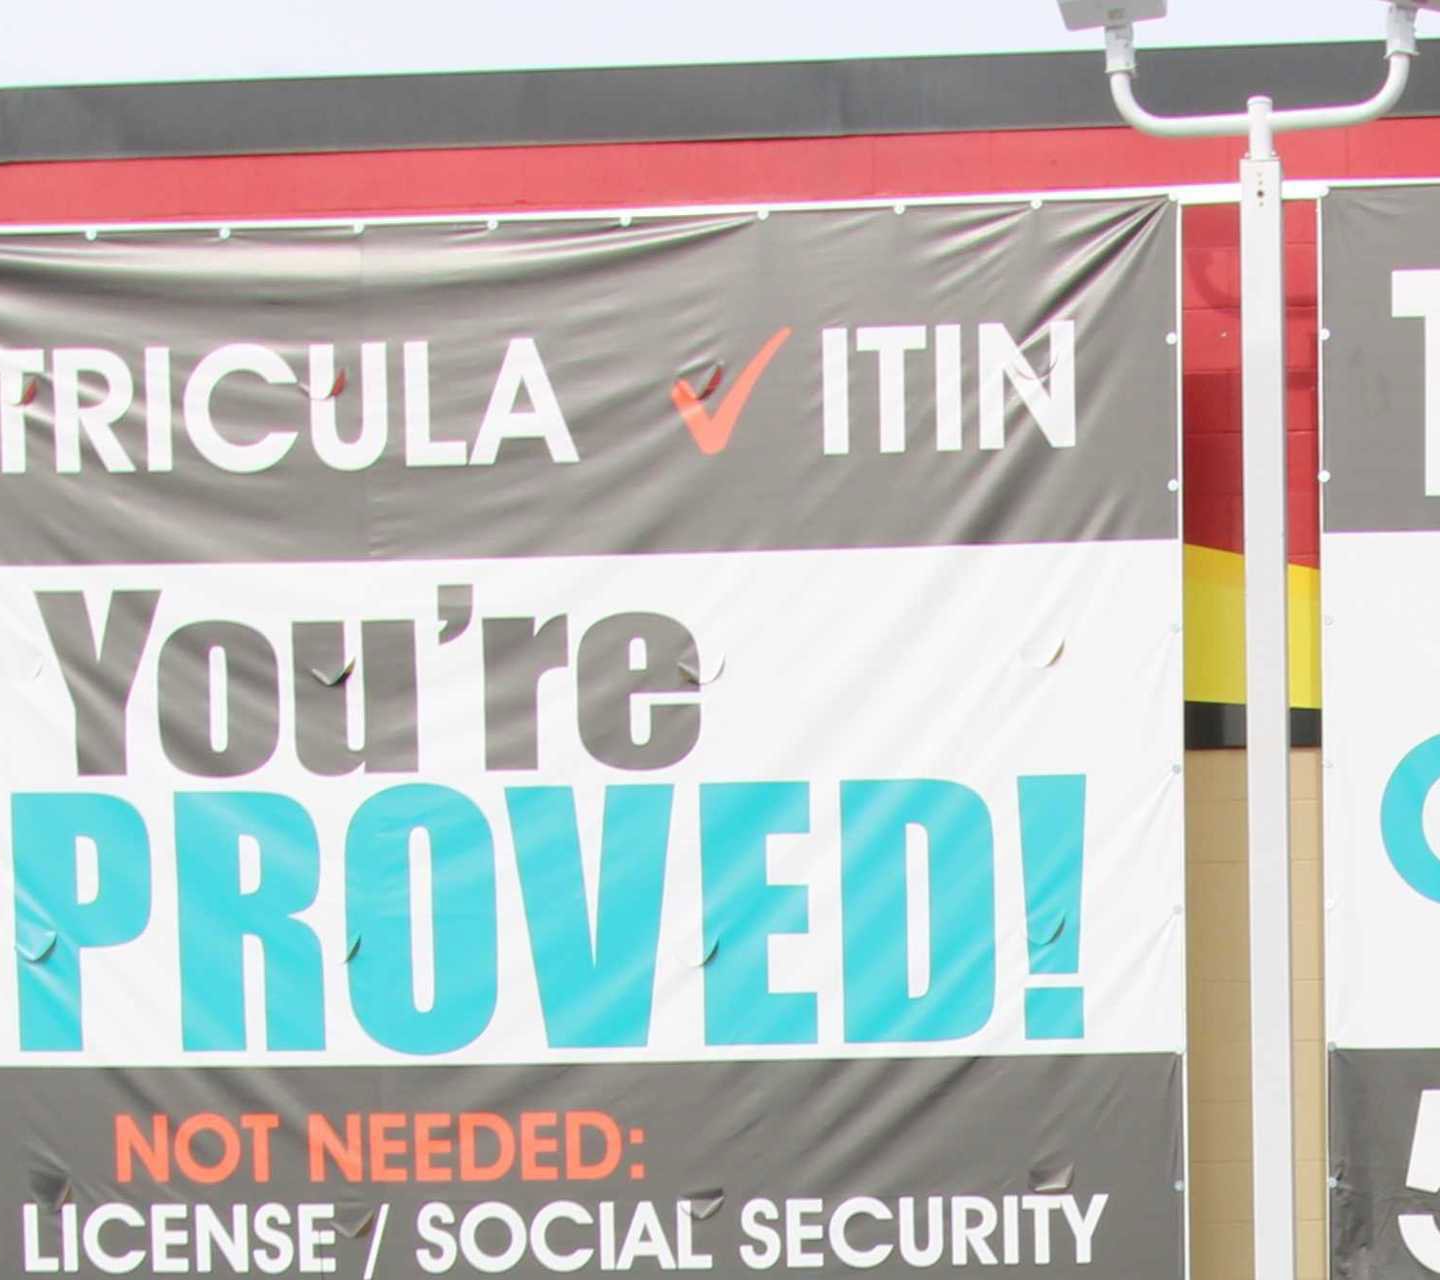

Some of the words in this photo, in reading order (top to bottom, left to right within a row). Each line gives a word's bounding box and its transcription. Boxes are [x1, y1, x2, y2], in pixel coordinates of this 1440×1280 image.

[820, 321, 1077, 455] ITIN
[36, 583, 704, 779] You're
[113, 1110, 281, 1185] NOT
[306, 1109, 646, 1185] NEEDED:
[22, 1201, 337, 1275] LICENSE
[415, 1198, 714, 1274] SOCIAL
[738, 1192, 1110, 1270] SECURITY
